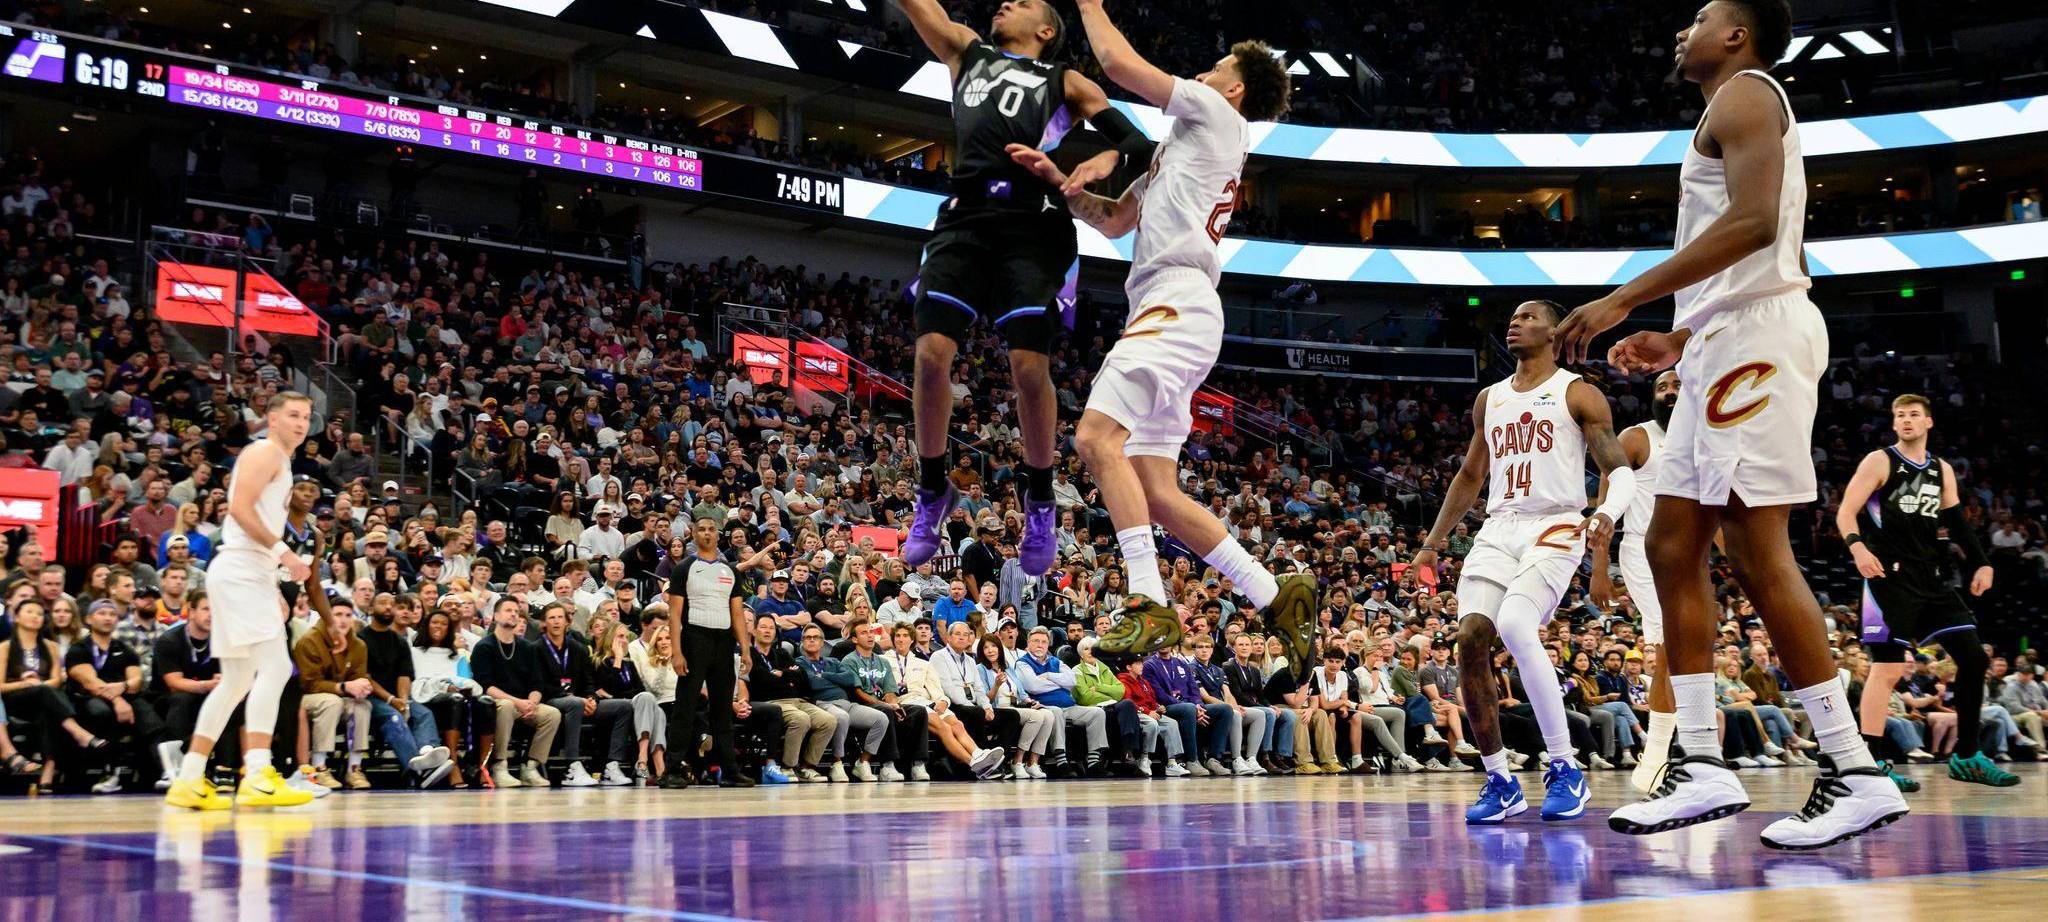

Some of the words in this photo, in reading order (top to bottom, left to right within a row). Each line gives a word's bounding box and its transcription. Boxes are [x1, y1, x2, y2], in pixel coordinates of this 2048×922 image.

[32, 32, 40, 41] 2
[75, 52, 129, 90] 6:19
[137, 80, 165, 97] 2ND
[145, 63, 163, 79] 17
[998, 85, 1025, 118] 0
[183, 89, 221, 107] 15/36
[222, 95, 259, 114] (42%)
[276, 106, 304, 121] 4/12
[306, 110, 340, 129] (33%)
[364, 120, 386, 135] 5/6
[388, 124, 421, 142] (83%)
[443, 134, 452, 146] 5
[470, 138, 480, 151] 11
[497, 143, 509, 156] 16
[524, 148, 537, 161] 12
[553, 153, 561, 165] 2
[581, 158, 586, 169] 1
[605, 162, 613, 174] 3
[633, 167, 640, 178] 7
[652, 169, 671, 183] 106
[677, 174, 696, 188] 126
[185, 72, 222, 89] 19/34
[224, 79, 260, 97] (56%)
[279, 88, 304, 103] 3/11
[306, 93, 339, 111] (27%)
[365, 103, 387, 118] 7/9
[388, 107, 420, 125] (78%)
[443, 117, 452, 129] 3
[470, 123, 482, 135] 17
[495, 127, 511, 140] 20
[524, 132, 537, 145] 12
[553, 138, 562, 149] 2
[580, 142, 588, 153] 3
[606, 147, 614, 158] 3
[630, 150, 643, 163] 13
[653, 154, 671, 168] 126
[677, 159, 696, 172] 106
[388, 95, 399, 106] FT
[524, 121, 539, 131] AST
[551, 125, 565, 136] STL
[577, 130, 591, 141] BLK
[603, 135, 617, 145] TOV
[626, 139, 648, 151] BENCH
[776, 172, 811, 203] 7:49
[815, 180, 840, 208] PM
[1308, 353, 1350, 366] HEALTH
[1705, 360, 1777, 430] C
[1490, 418, 1554, 459] CAVS
[1503, 460, 1532, 500] 14
[1920, 495, 1941, 519] 22
